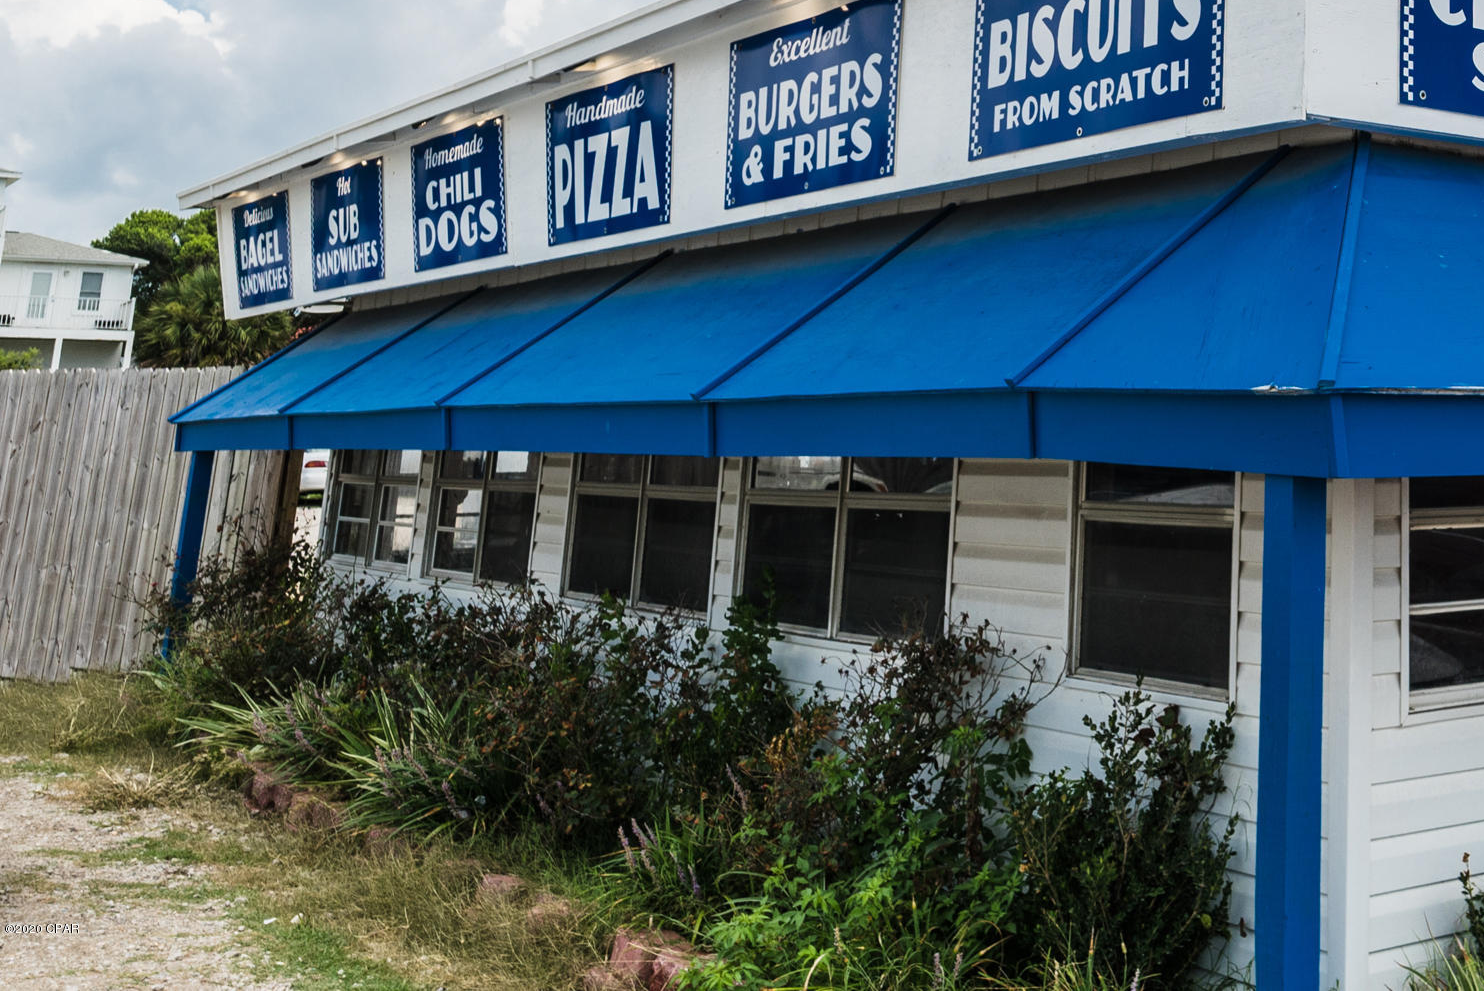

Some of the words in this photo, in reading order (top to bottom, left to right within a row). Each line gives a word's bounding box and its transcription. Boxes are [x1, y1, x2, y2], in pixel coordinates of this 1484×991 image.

[769, 18, 851, 67] Excellent
[565, 85, 645, 128] Handmade
[738, 52, 883, 141] BURGERS
[993, 90, 1060, 133] FROM
[1068, 58, 1189, 116] SCRATCH
[423, 133, 484, 170] Homemade
[741, 144, 764, 186] &
[772, 117, 872, 180] FRIES
[336, 176, 351, 197] Hot
[425, 167, 482, 210] CHILI
[554, 120, 660, 229] PIZZA
[243, 206, 274, 227] Delicious
[328, 203, 360, 246] SUB
[418, 199, 498, 257] DOGS
[239, 229, 283, 270] BAGEL
[316, 239, 378, 279] SANDWICHES
[240, 266, 288, 297] SANDWICHES
